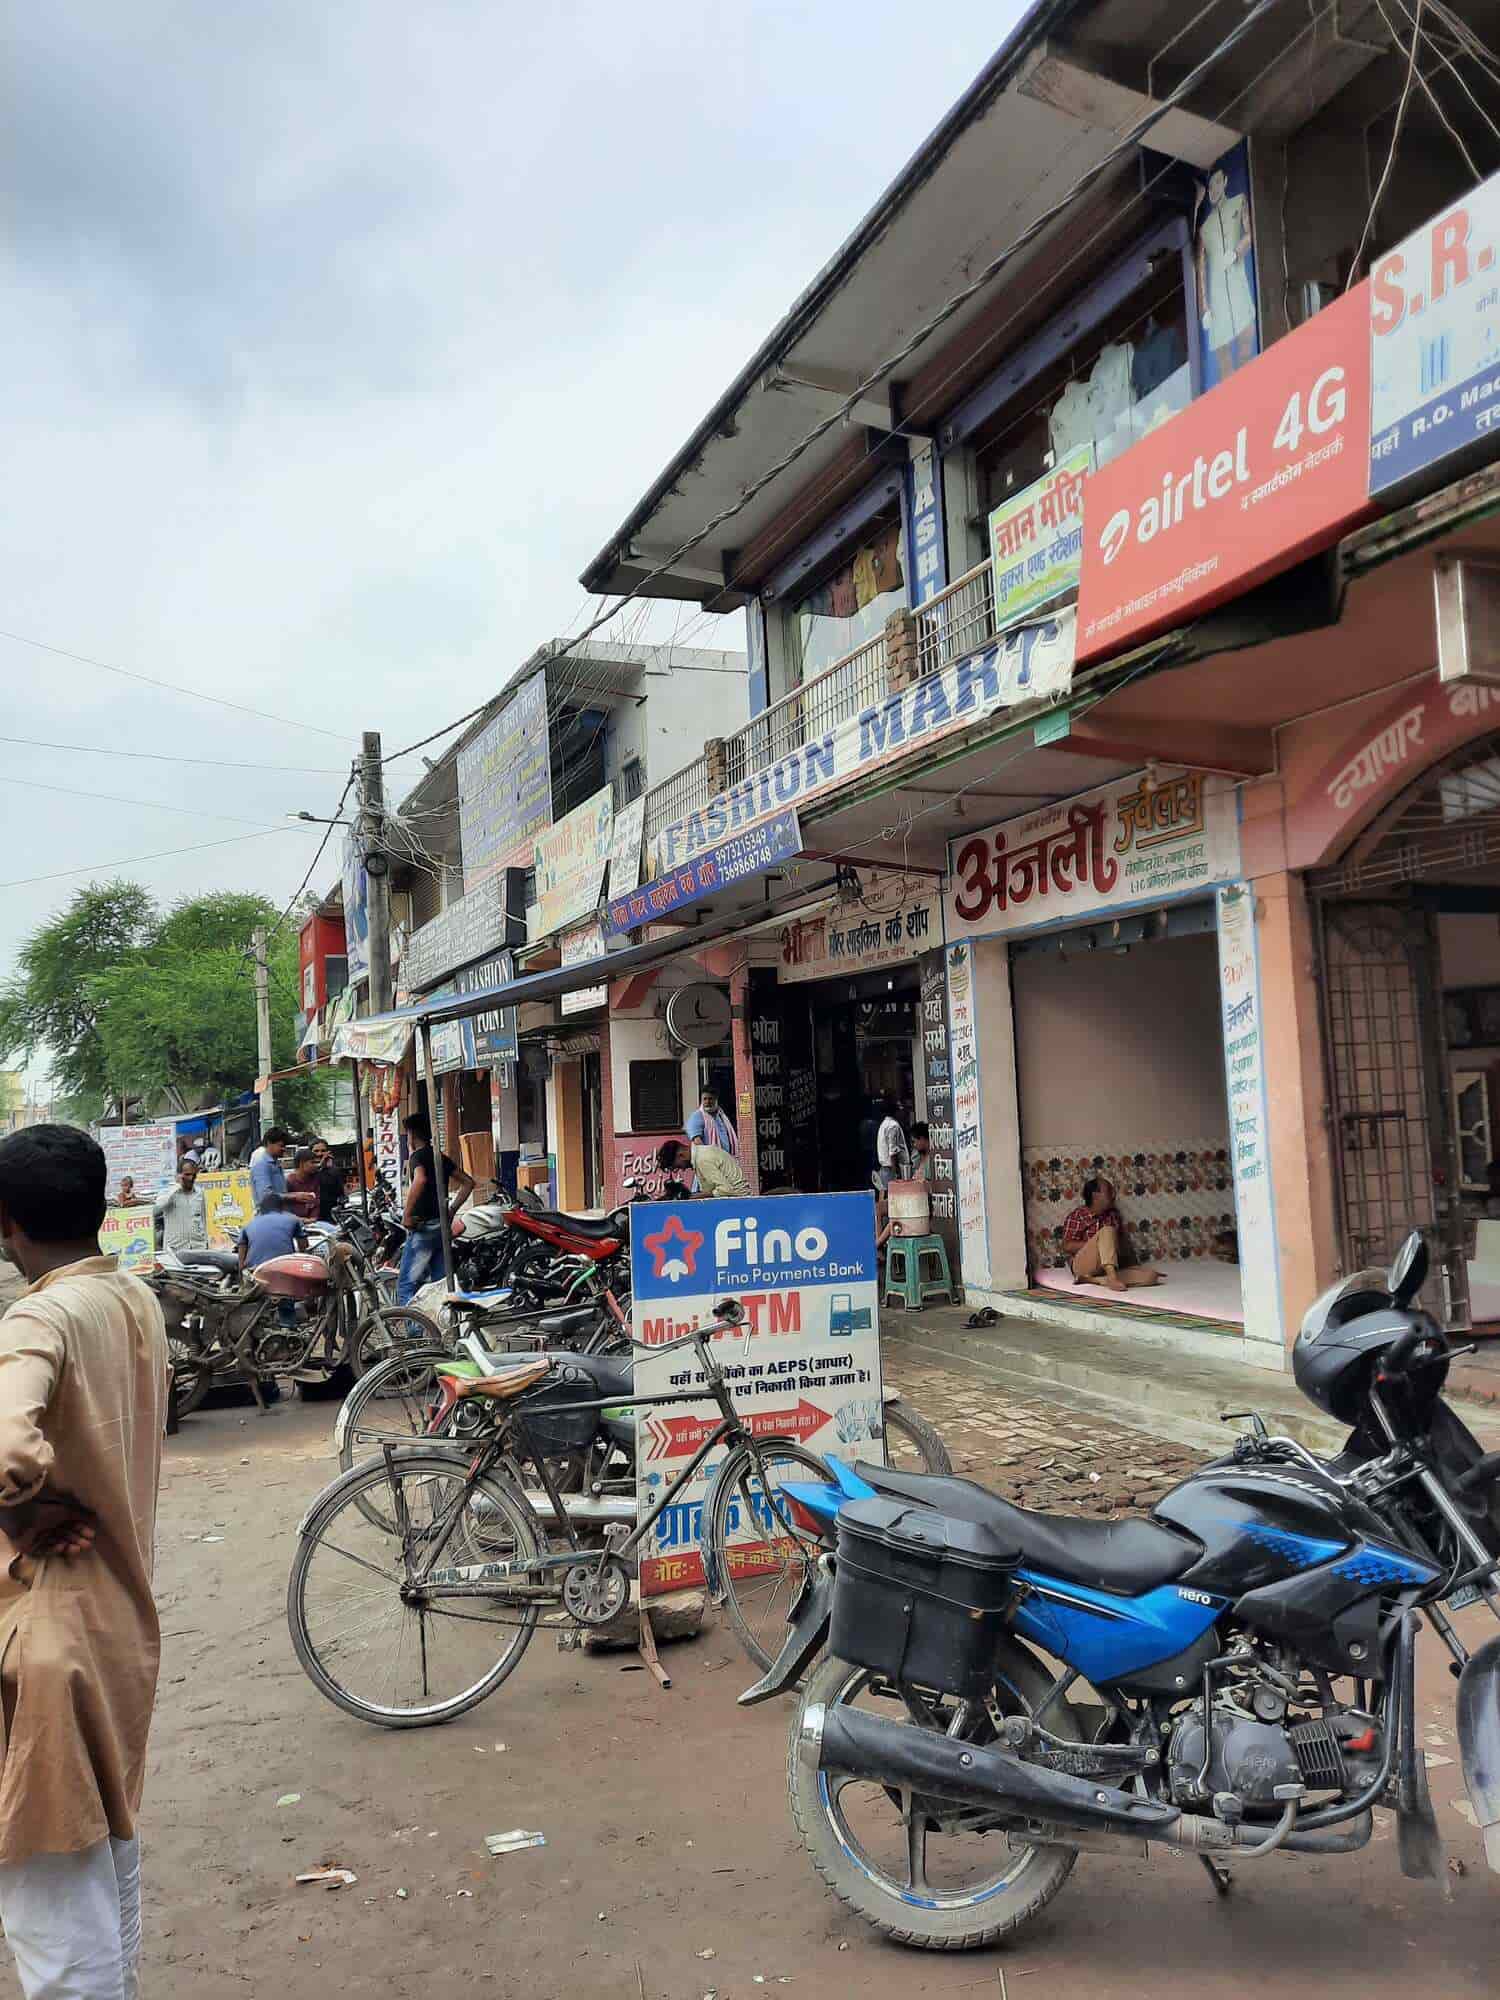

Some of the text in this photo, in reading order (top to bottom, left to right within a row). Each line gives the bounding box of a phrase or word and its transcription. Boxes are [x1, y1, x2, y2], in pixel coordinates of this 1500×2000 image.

[1273, 366, 1347, 452] 4G
[1411, 404, 1454, 438] R.O.
[1137, 427, 1251, 544] airtel
[857, 617, 1060, 763] MART
[1327, 703, 1426, 809] व्यापार
[954, 800, 1118, 923] अंजली
[716, 1261, 864, 1286] Fino Payments Bank
[642, 1315, 700, 1345] Mini
[735, 1381, 752, 1397] एवं
[799, 1371, 826, 1390] किया
[829, 1370, 855, 1388] जाता
[748, 1363, 764, 1377] का
